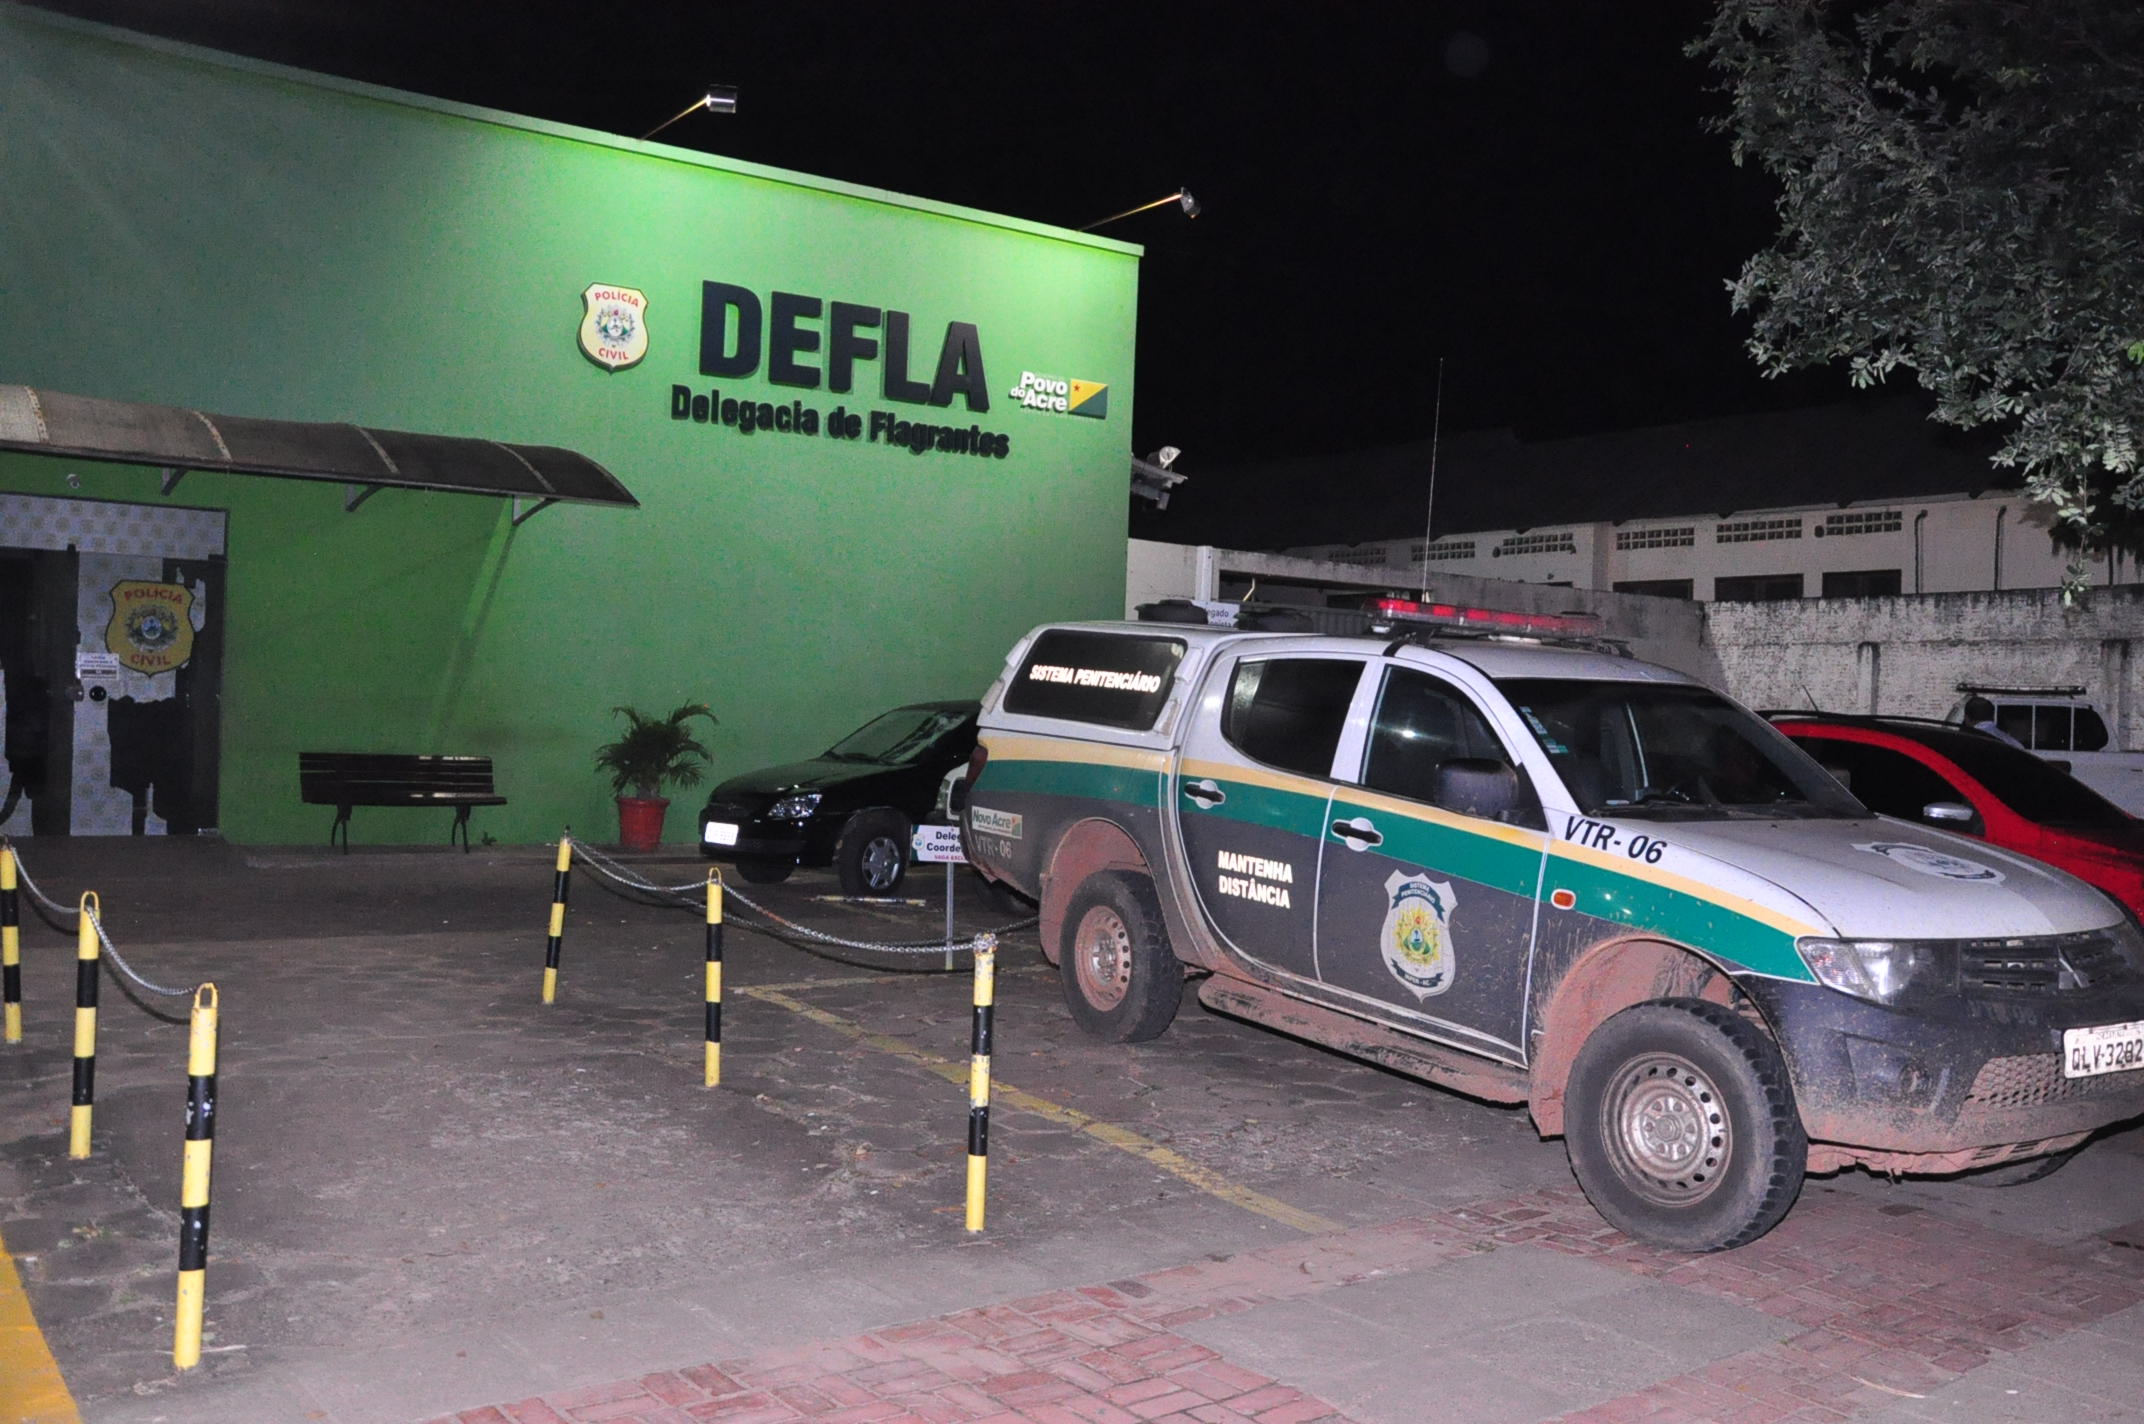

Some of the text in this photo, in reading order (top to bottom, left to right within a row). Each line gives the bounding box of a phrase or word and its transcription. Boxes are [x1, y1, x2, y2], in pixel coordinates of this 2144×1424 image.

[598, 347, 629, 360] CIVIL
[699, 280, 990, 413] DEFLA
[1020, 371, 1068, 395] Povo
[1010, 386, 1068, 411] do Acre
[670, 384, 1010, 459] Delegacia de Flagrantes
[131, 654, 171, 666] CIVIL
[1029, 664, 1161, 693] SISTEMA PENITENCIÁRIO
[972, 808, 992, 825] Novo
[992, 812, 1011, 829] Acre
[926, 842, 961, 852] Coorde
[1218, 850, 1293, 884] MANTENHA
[1218, 875, 1291, 909] DISTÂNCIA
